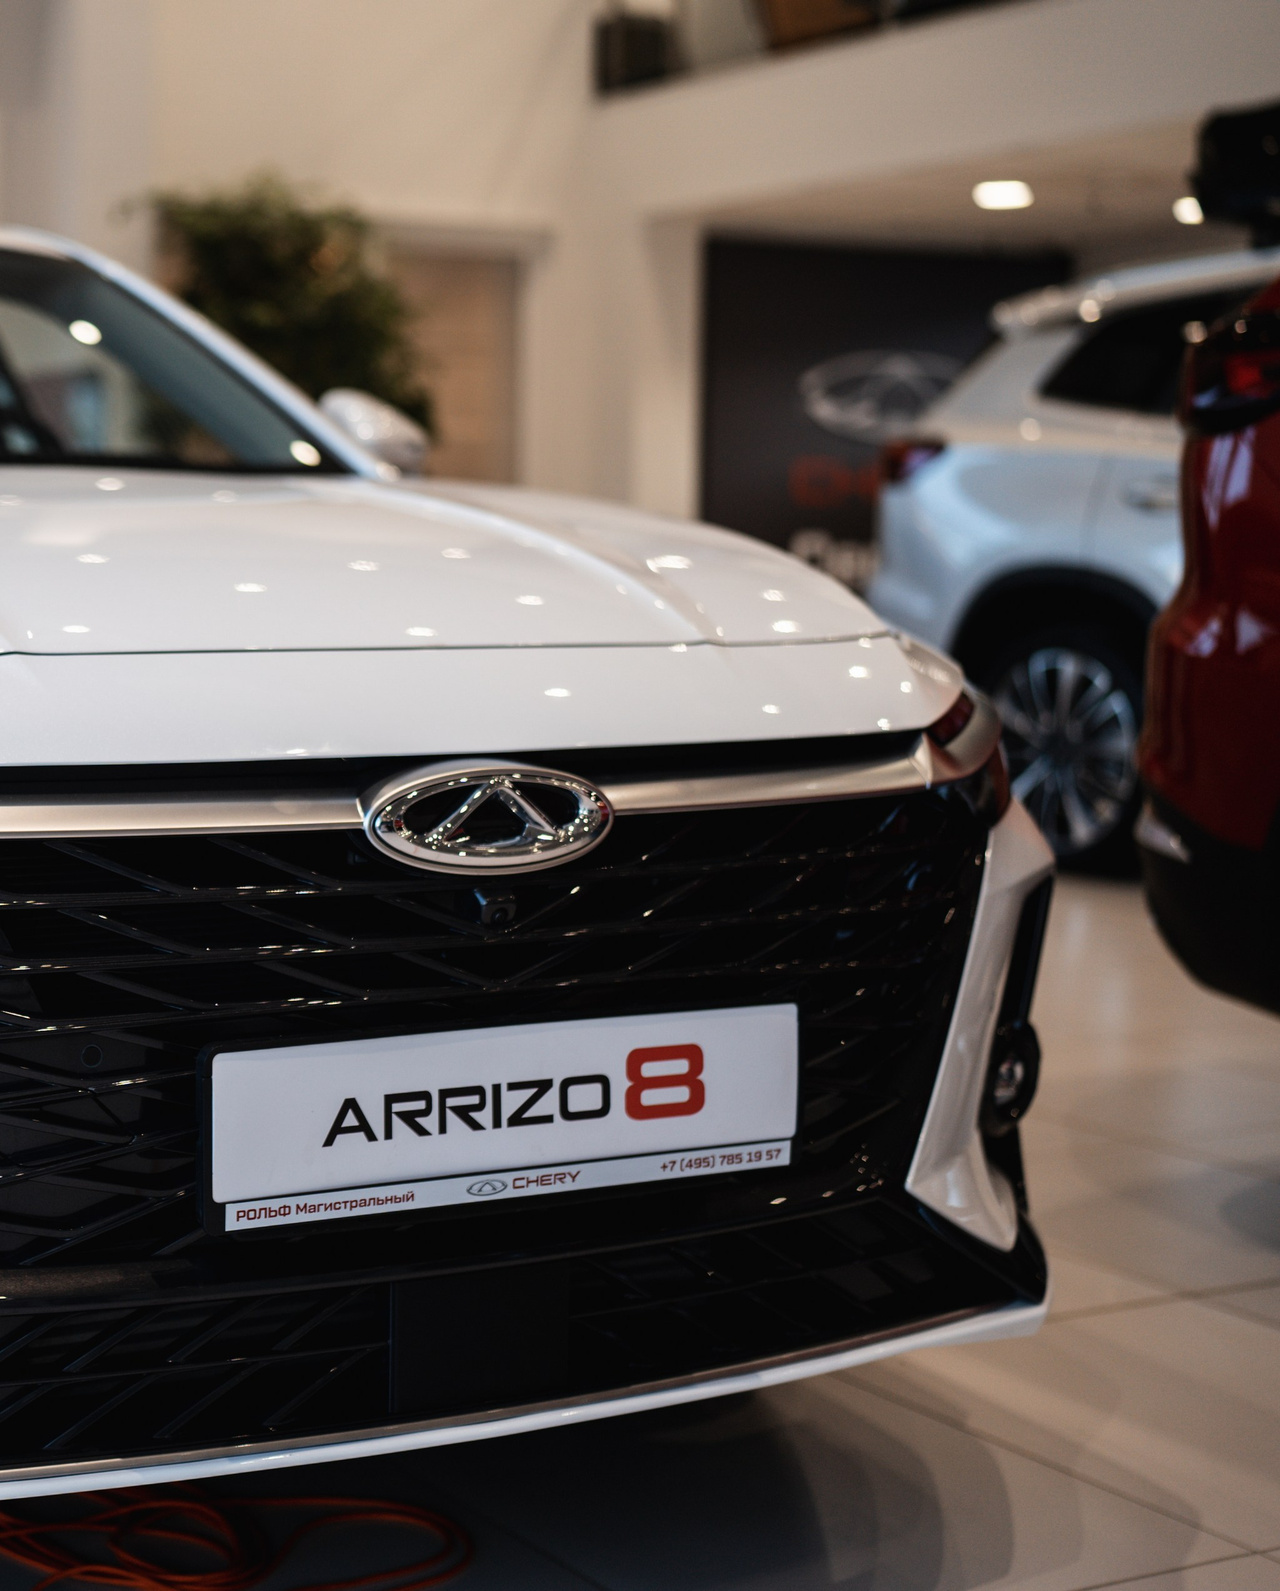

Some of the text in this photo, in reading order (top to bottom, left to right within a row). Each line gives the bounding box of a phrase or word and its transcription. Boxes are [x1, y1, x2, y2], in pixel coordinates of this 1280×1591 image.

[321, 1043, 706, 1148] ARRIZO 8
[660, 1148, 782, 1172] +7 (495) 785 19 57
[512, 1170, 581, 1190] CHERY
[235, 1191, 416, 1222] РОЛЬФ Магистральный
